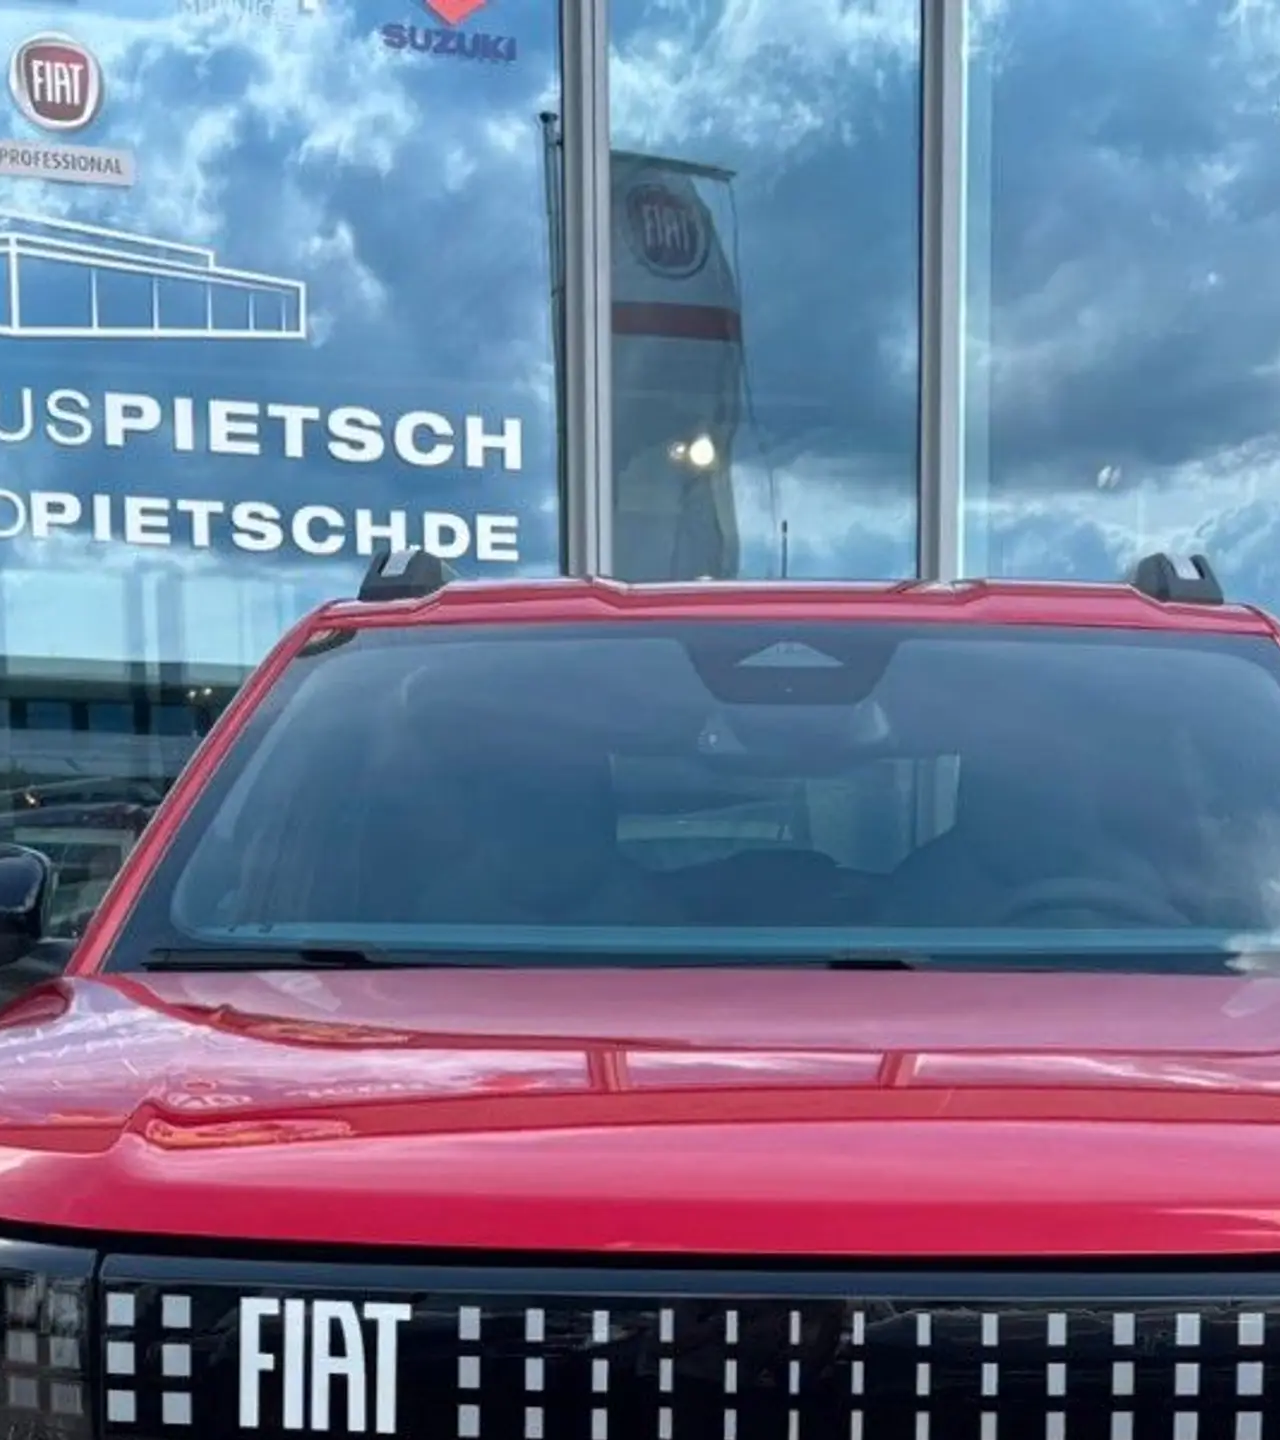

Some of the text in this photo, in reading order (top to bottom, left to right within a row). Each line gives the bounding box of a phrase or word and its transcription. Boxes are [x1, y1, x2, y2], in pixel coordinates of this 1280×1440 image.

[381, 23, 518, 62] SUZUKI
[31, 60, 84, 105] FIAT
[239, 1297, 412, 1434] FIAT
